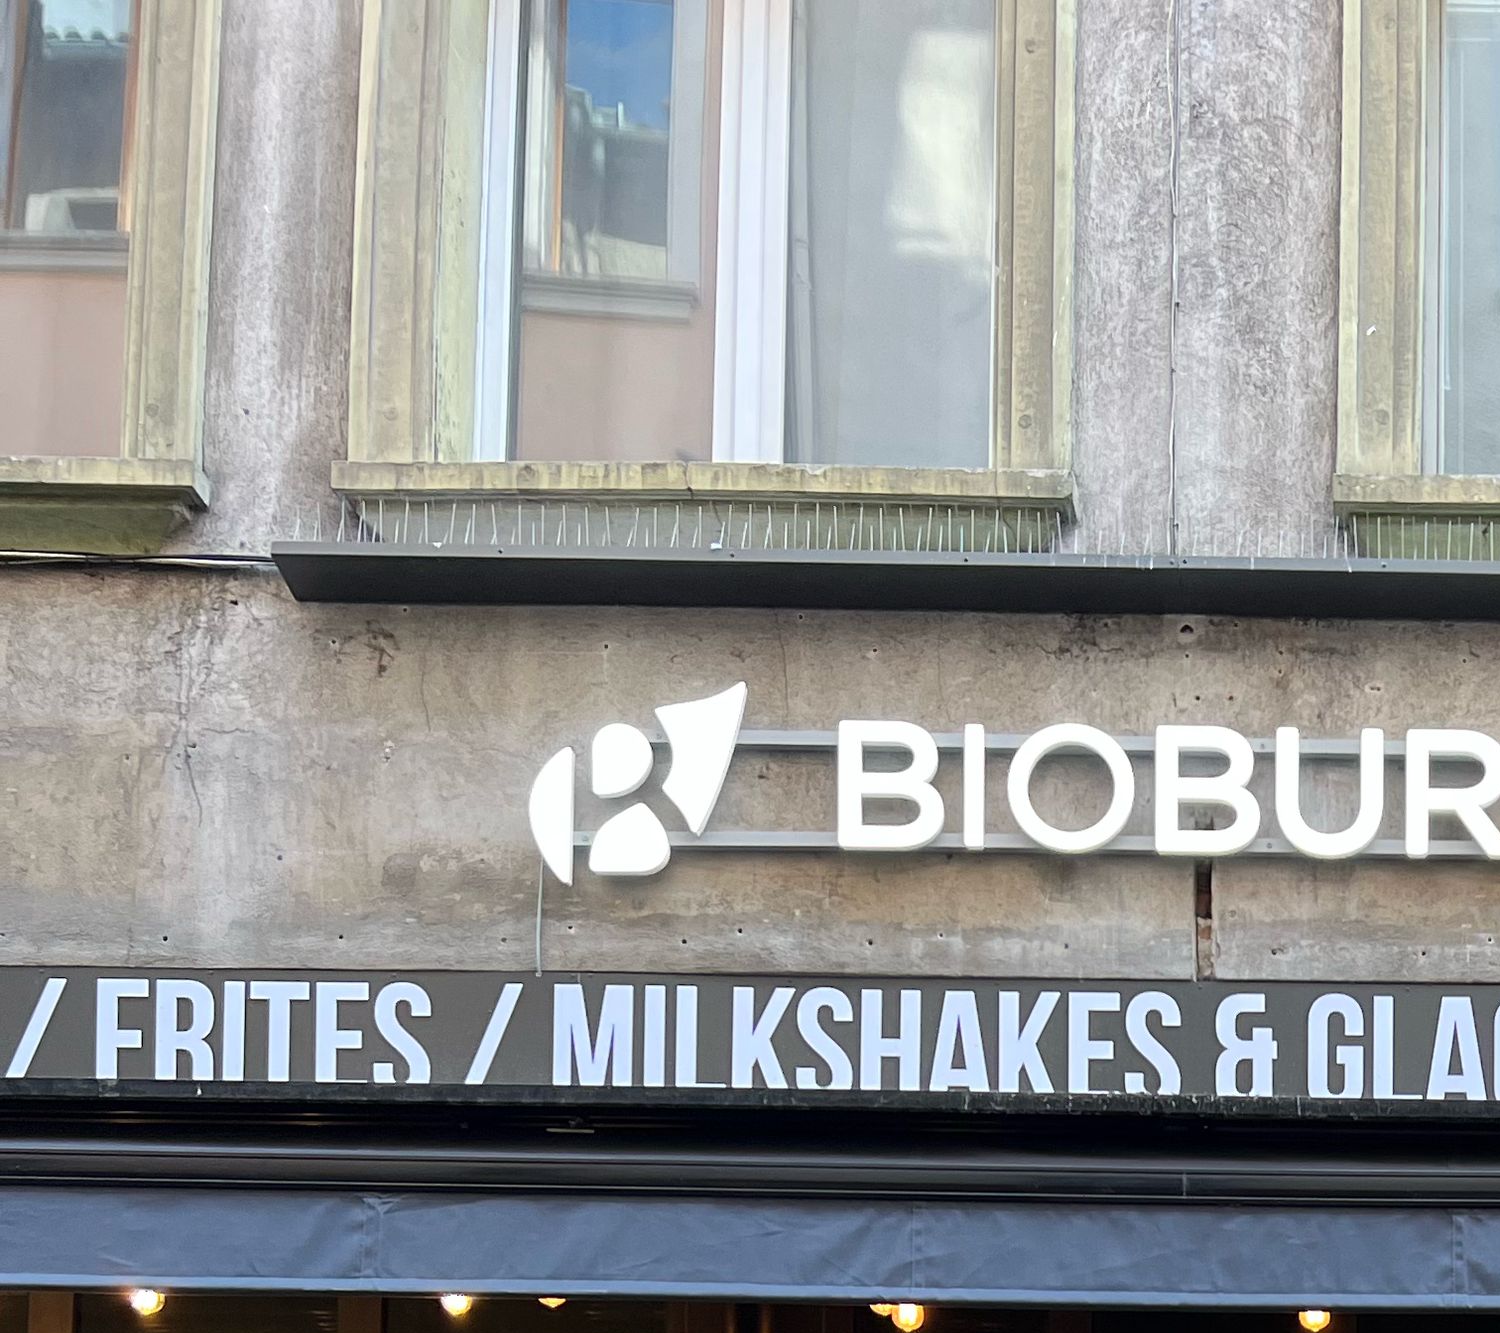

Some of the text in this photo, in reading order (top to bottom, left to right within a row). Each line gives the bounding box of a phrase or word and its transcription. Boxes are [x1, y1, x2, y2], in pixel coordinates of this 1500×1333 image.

[95, 978, 432, 1084] FRITES
[552, 983, 1182, 1096] MILKSHAKES
[1215, 992, 1279, 1098] &
